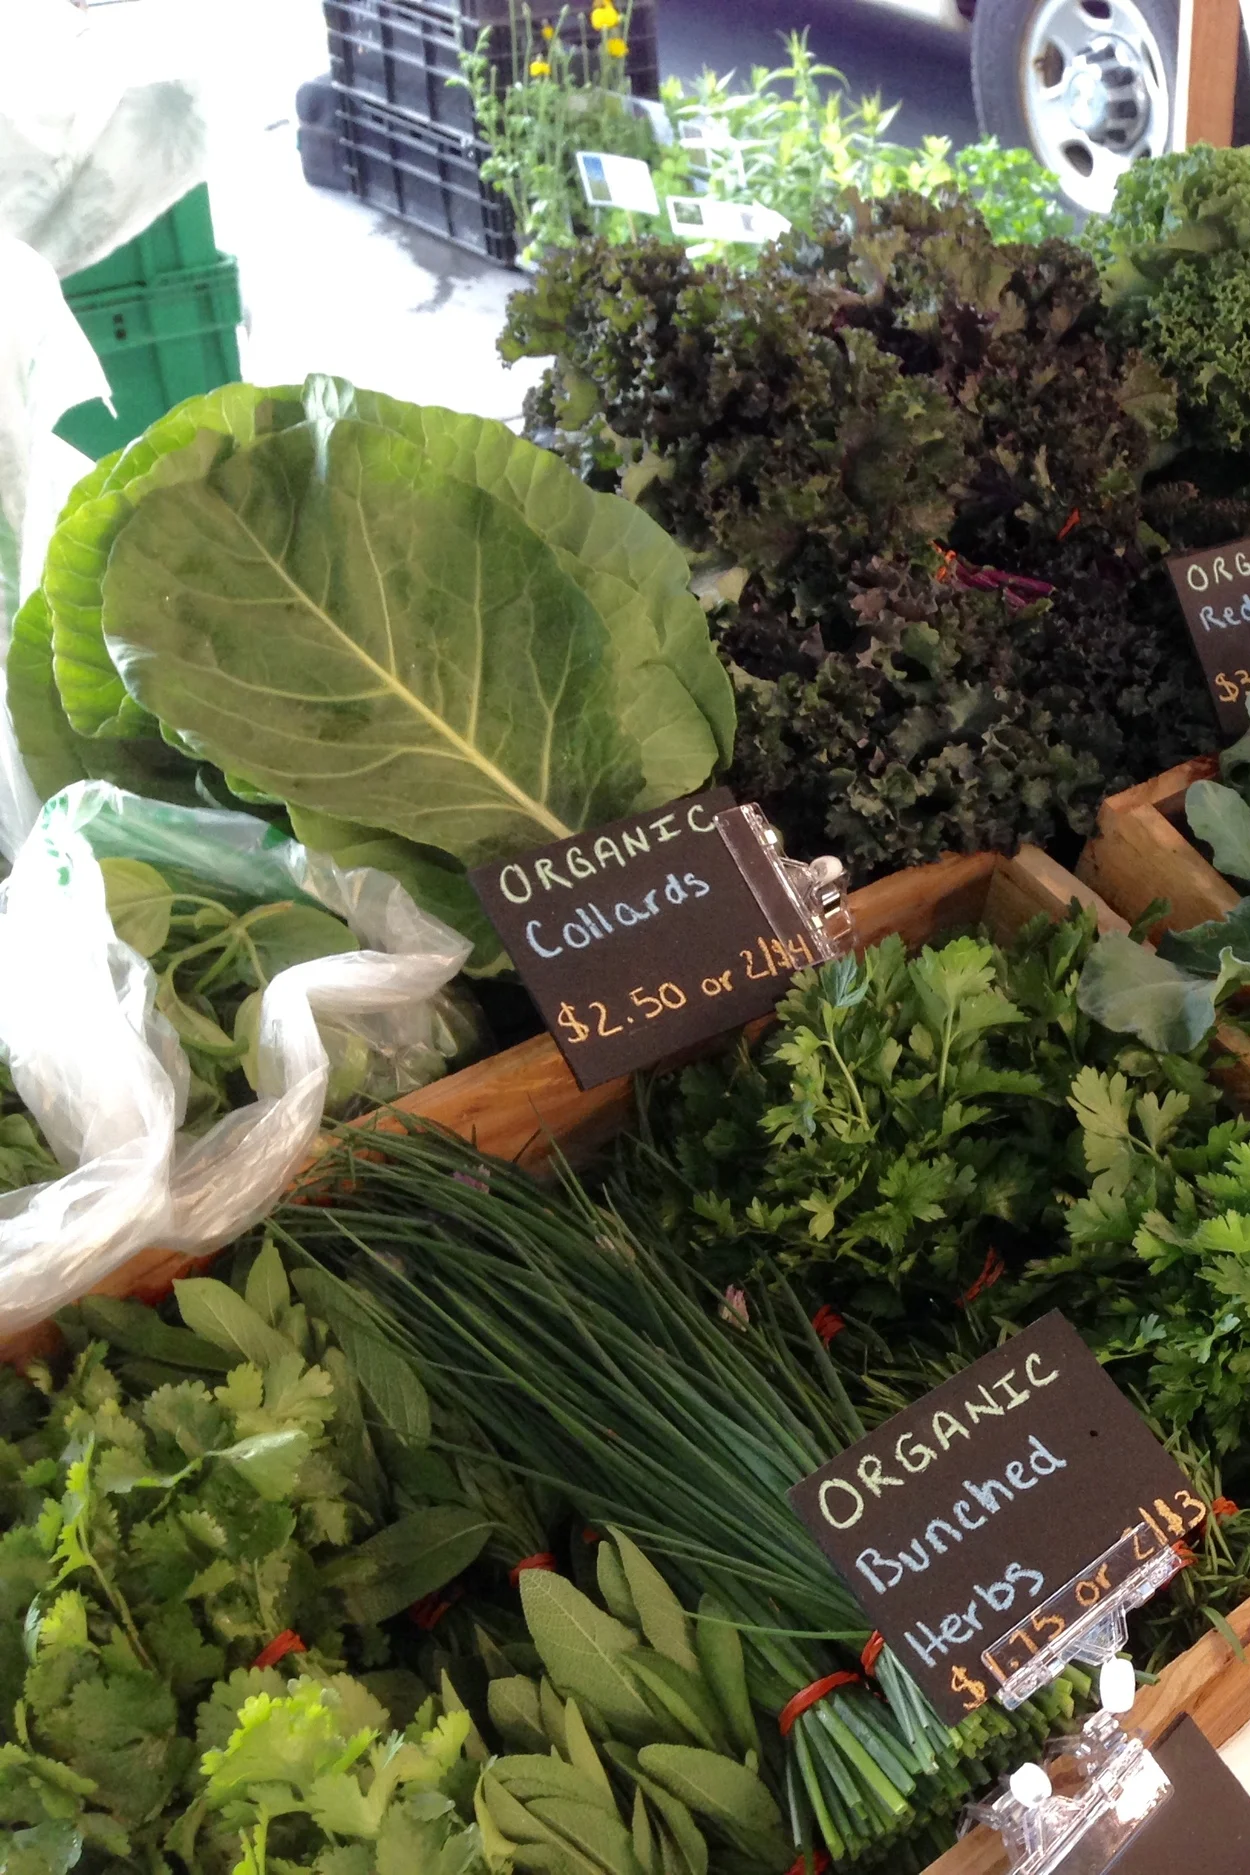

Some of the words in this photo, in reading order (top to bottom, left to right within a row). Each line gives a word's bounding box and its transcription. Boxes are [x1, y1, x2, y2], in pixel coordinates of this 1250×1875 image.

[500, 804, 716, 904] ORGANIC
[526, 872, 710, 959] Collards
[558, 981, 687, 1044] $2.50
[701, 969, 734, 997] or
[739, 933, 812, 980] 2/$4
[817, 1353, 1059, 1529] ORGANIC
[855, 1434, 1067, 1594] Bunched
[904, 1562, 1044, 1668] Herbs
[1075, 1563, 1110, 1606] or
